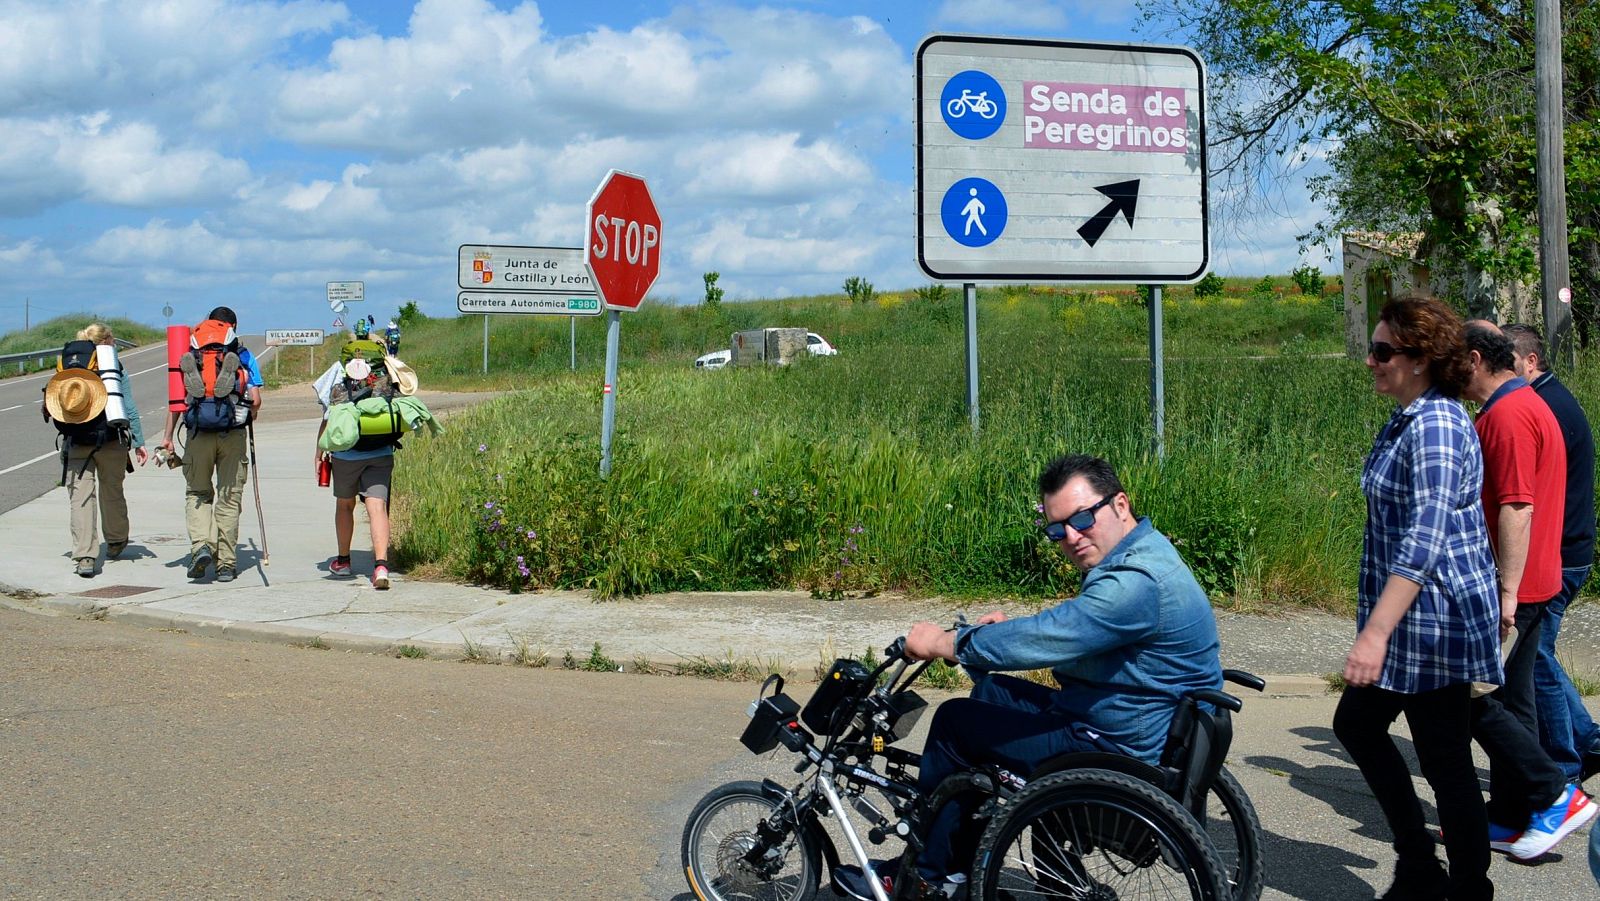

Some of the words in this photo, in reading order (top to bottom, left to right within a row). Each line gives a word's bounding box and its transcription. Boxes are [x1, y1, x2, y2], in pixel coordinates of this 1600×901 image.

[1029, 85, 1127, 115] Senda
[1143, 91, 1180, 117] de
[1024, 116, 1188, 151] Peregrinos
[593, 214, 658, 267] STOP
[504, 258, 540, 269] Junta
[543, 259, 558, 269] de
[504, 272, 547, 283] Castilla
[550, 275, 557, 286] y
[561, 273, 589, 284] León
[461, 297, 506, 307] Carretera
[510, 299, 566, 308] Autonómica
[568, 301, 597, 309] P-980
